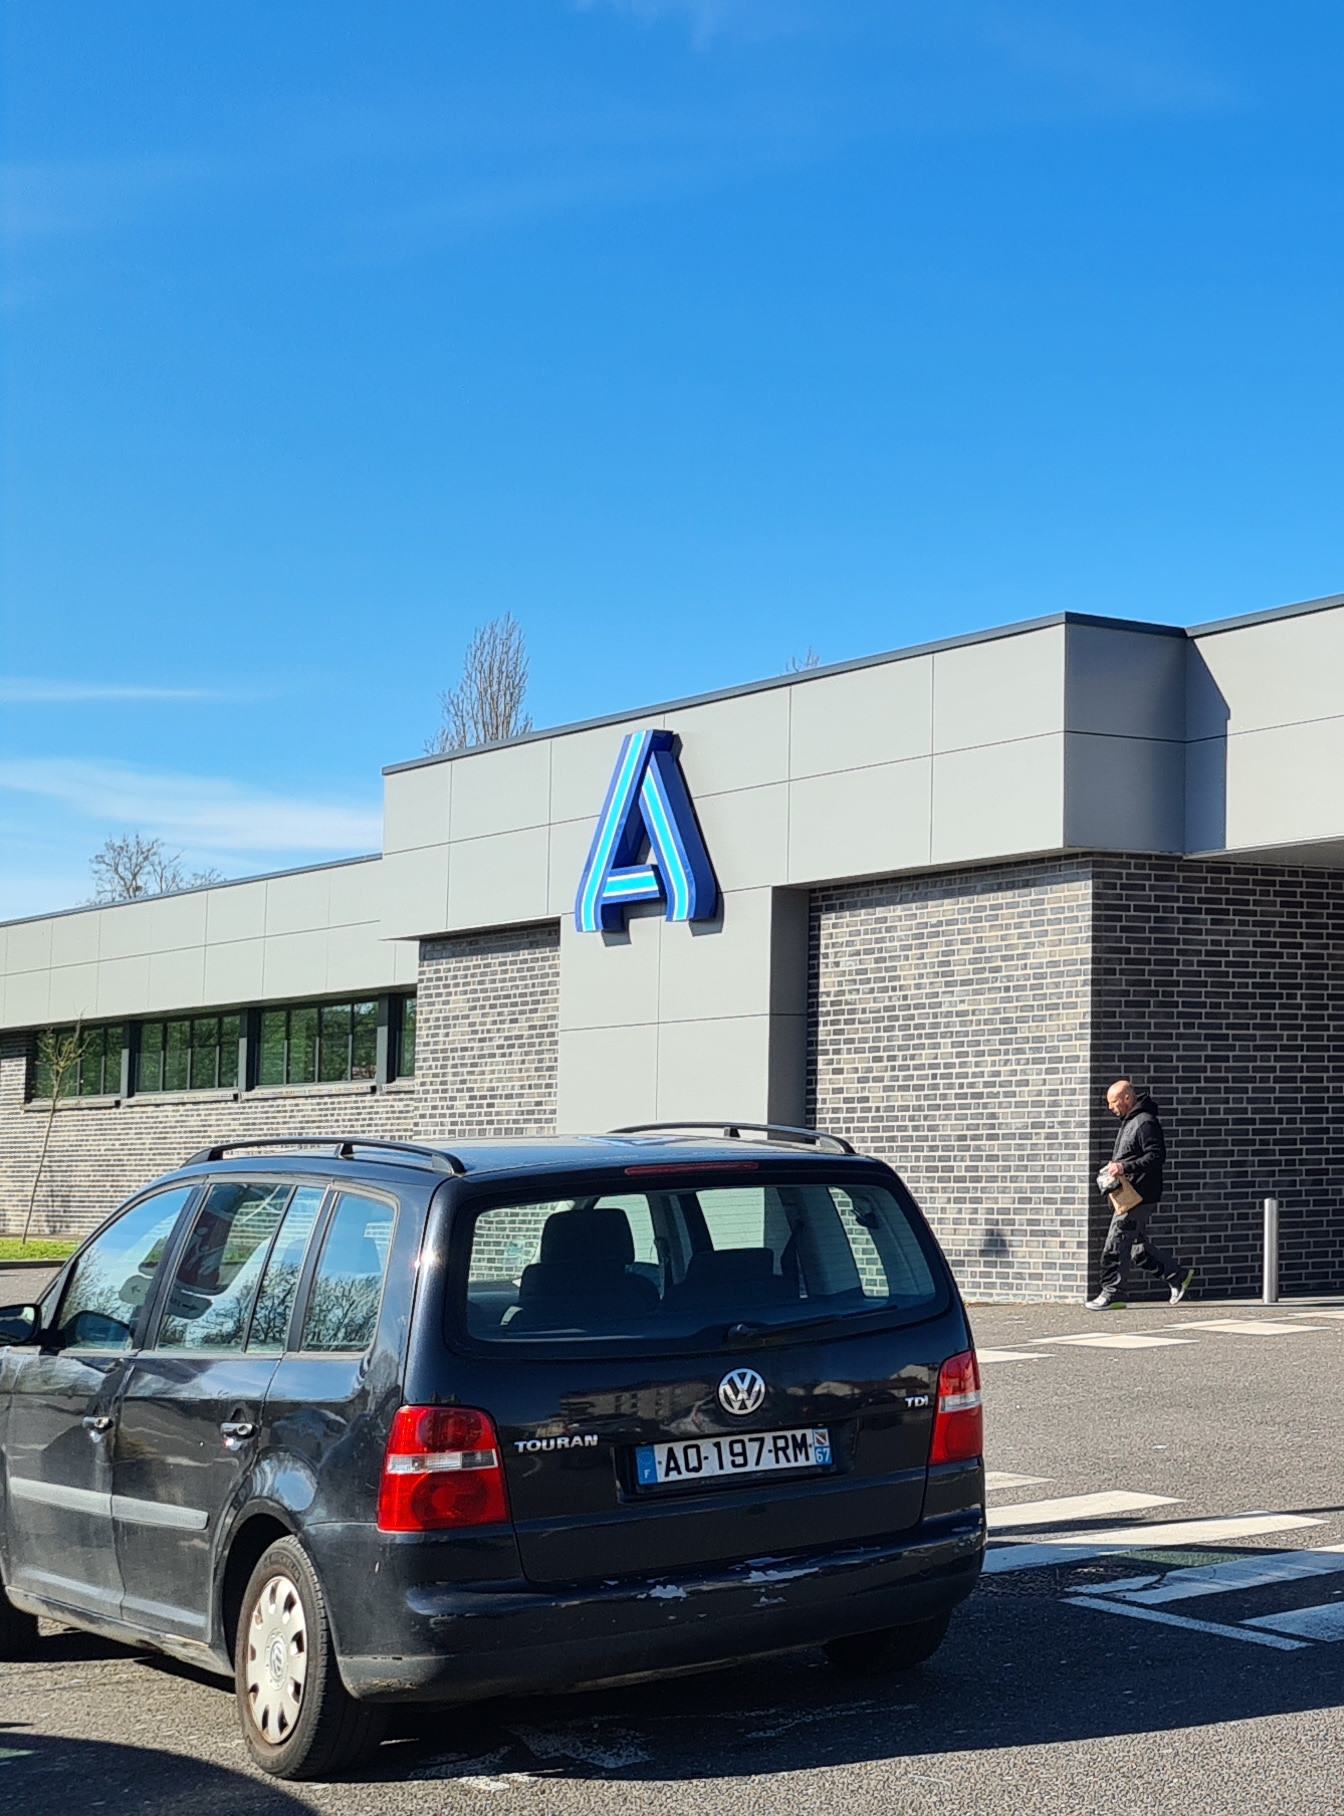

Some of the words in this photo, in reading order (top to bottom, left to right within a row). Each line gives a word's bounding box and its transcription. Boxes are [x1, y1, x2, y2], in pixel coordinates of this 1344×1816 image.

[513, 1433, 599, 1454] TOURAN
[663, 1433, 811, 1478] AQ-197-RM
[815, 1447, 831, 1465] 67
